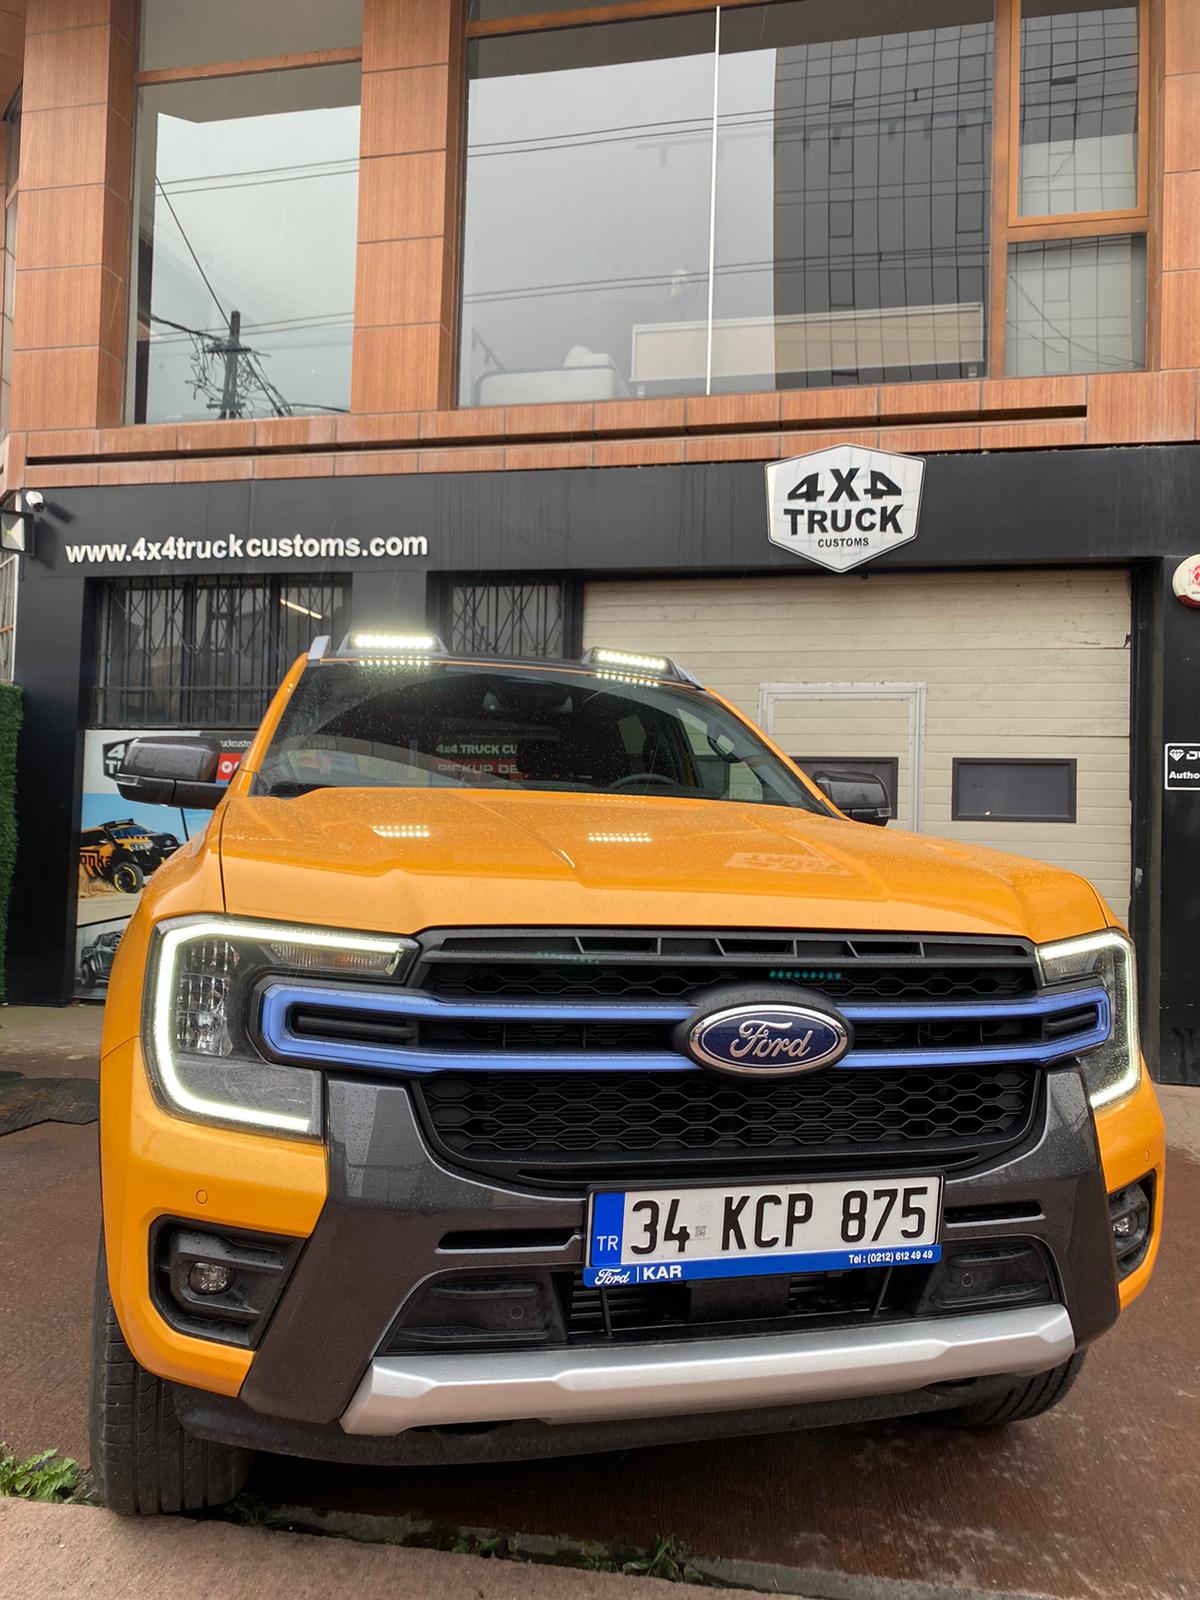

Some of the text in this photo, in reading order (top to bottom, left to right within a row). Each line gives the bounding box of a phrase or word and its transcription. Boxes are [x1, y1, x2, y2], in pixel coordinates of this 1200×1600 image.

[787, 468, 902, 503] 4X4
[783, 504, 905, 536] TRUCK
[66, 534, 428, 563] www.4x4truckcustoms.com
[818, 537, 869, 548] CUSTOMS
[461, 744, 499, 754] TRUCK
[437, 764, 493, 774] PICKUP
[730, 1020, 813, 1058] Ford
[630, 1187, 928, 1255] 34 KCP 875
[597, 1235, 618, 1251] TR
[867, 1252, 894, 1264] (0212)
[895, 1251, 909, 1260] 612
[910, 1251, 922, 1259] 49
[922, 1250, 933, 1259] 49
[595, 1265, 682, 1285] Ford KAR
